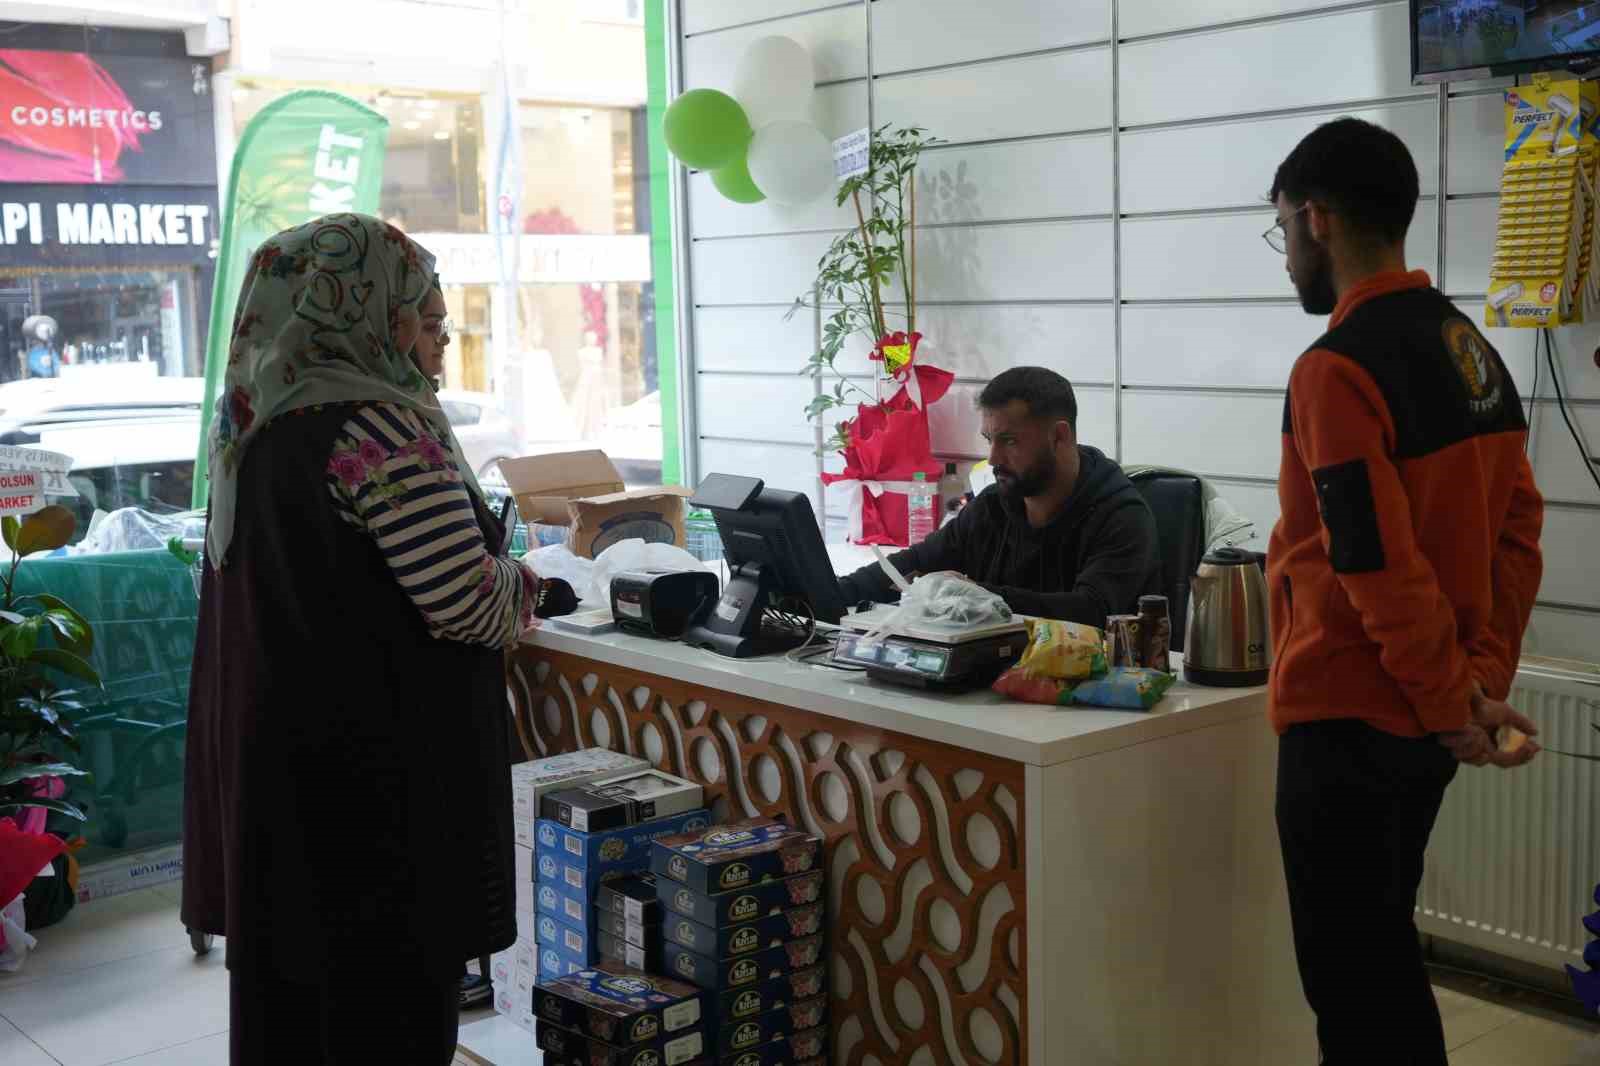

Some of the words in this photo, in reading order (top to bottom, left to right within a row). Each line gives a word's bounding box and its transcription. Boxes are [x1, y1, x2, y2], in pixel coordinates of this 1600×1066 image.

[11, 106, 162, 130] COSMETICS
[1513, 111, 1554, 124] PERFECT
[0, 202, 43, 245] PI
[57, 202, 209, 245] MARKET
[0, 474, 34, 488] OLSUN
